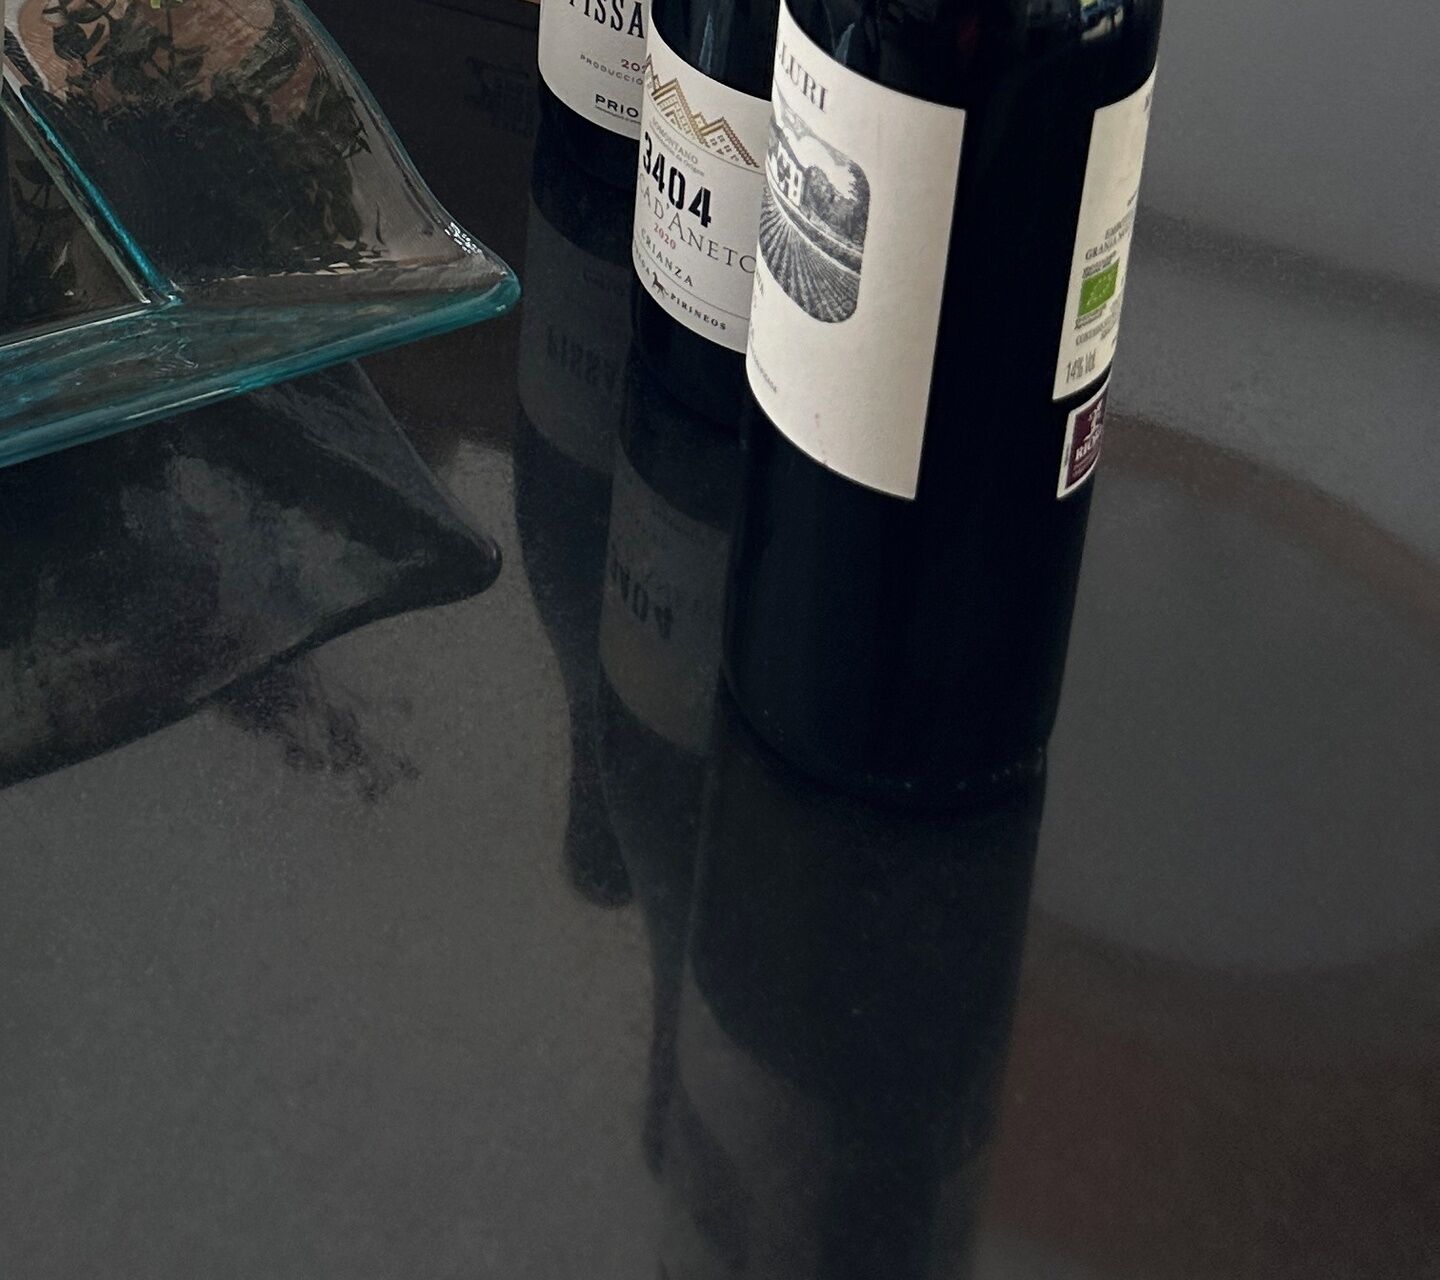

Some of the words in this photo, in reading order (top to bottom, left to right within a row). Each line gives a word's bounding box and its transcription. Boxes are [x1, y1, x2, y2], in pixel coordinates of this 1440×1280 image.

[777, 41, 829, 114] LURI
[595, 93, 639, 118] PRIO
[643, 130, 712, 229] 3404
[641, 227, 694, 288] CRIANZA
[653, 222, 677, 251] 2020
[670, 292, 727, 331] PIRINEOS
